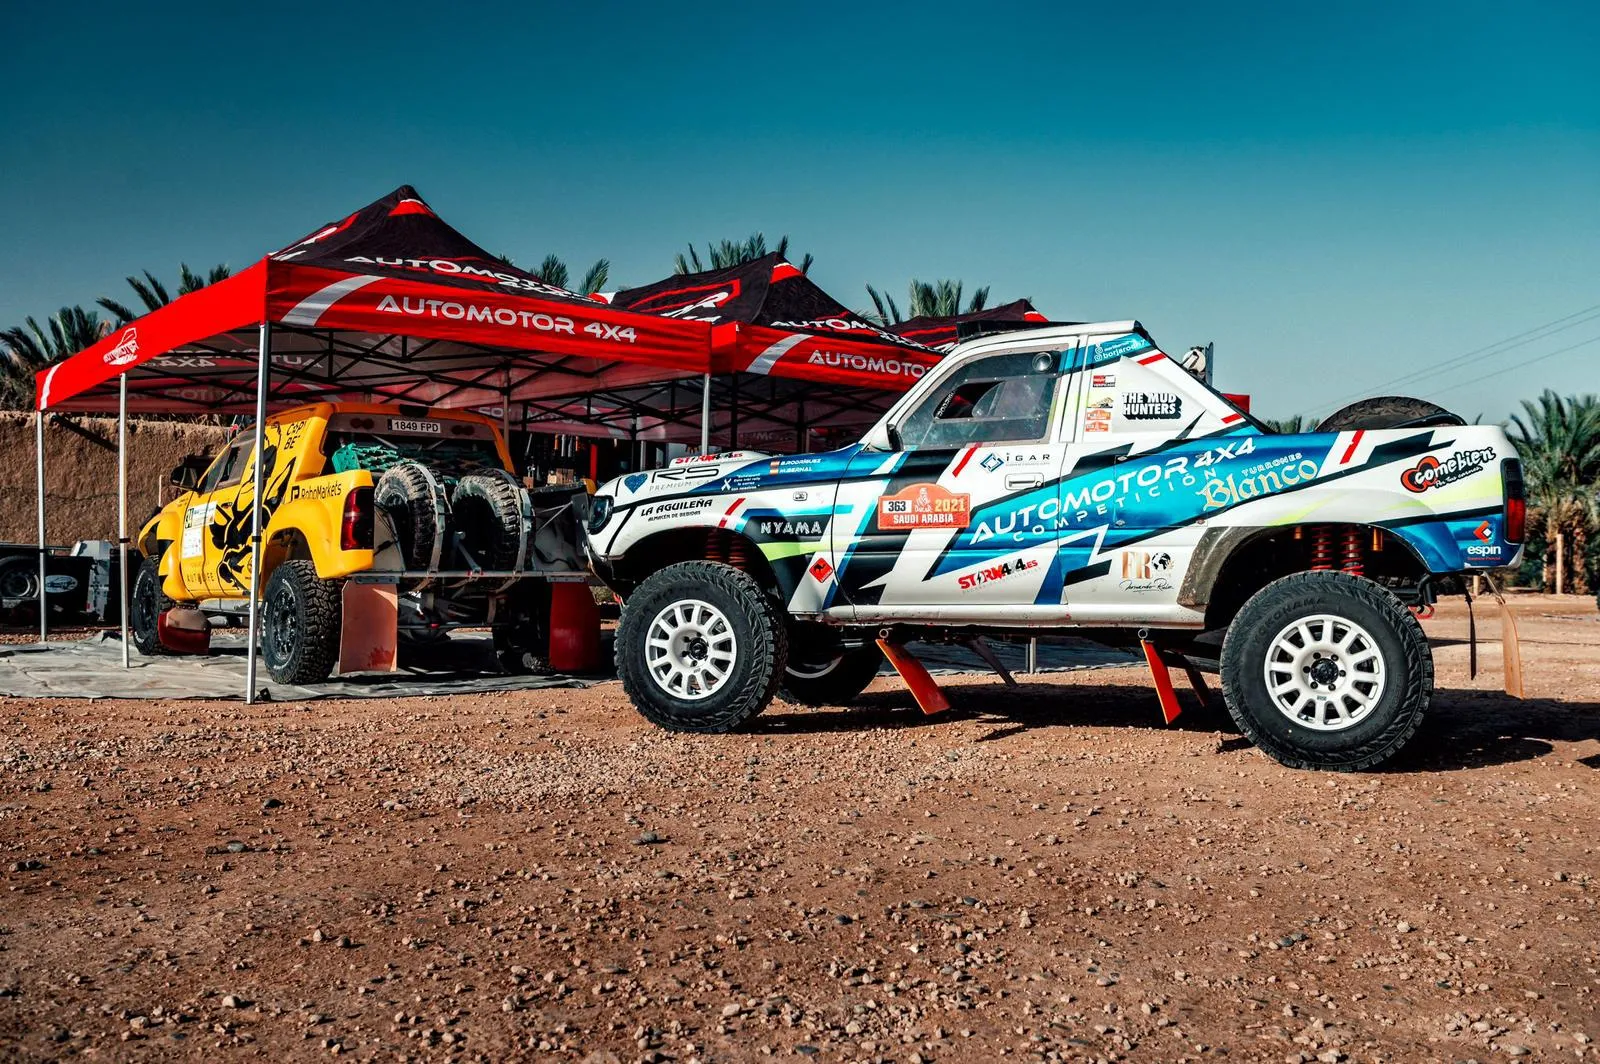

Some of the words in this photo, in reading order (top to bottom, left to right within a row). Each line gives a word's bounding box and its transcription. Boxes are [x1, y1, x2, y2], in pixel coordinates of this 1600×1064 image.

[376, 295, 576, 335] AUTOMOTOR
[1121, 392, 1144, 404] THE
[1147, 392, 1177, 404] MUD
[1122, 403, 1177, 415] HUNTERS
[394, 421, 418, 431] 1849
[420, 422, 439, 432] FPD
[1241, 452, 1303, 477] TURRONES
[651, 464, 721, 483] RS
[969, 456, 1189, 545] AUTOMOTOR
[1193, 437, 1257, 468] 4X4
[1195, 460, 1319, 512] Blanco
[641, 506, 654, 517] LA
[656, 498, 713, 514] AGUILEÑA
[888, 501, 906, 512] 363
[934, 499, 966, 512] 2021
[1013, 467, 1217, 542] COMPETICIÓN
[893, 513, 919, 524] SAUDI
[921, 513, 954, 523] ARABIA
[760, 520, 822, 535] NYAMA
[1467, 545, 1502, 557] espin
